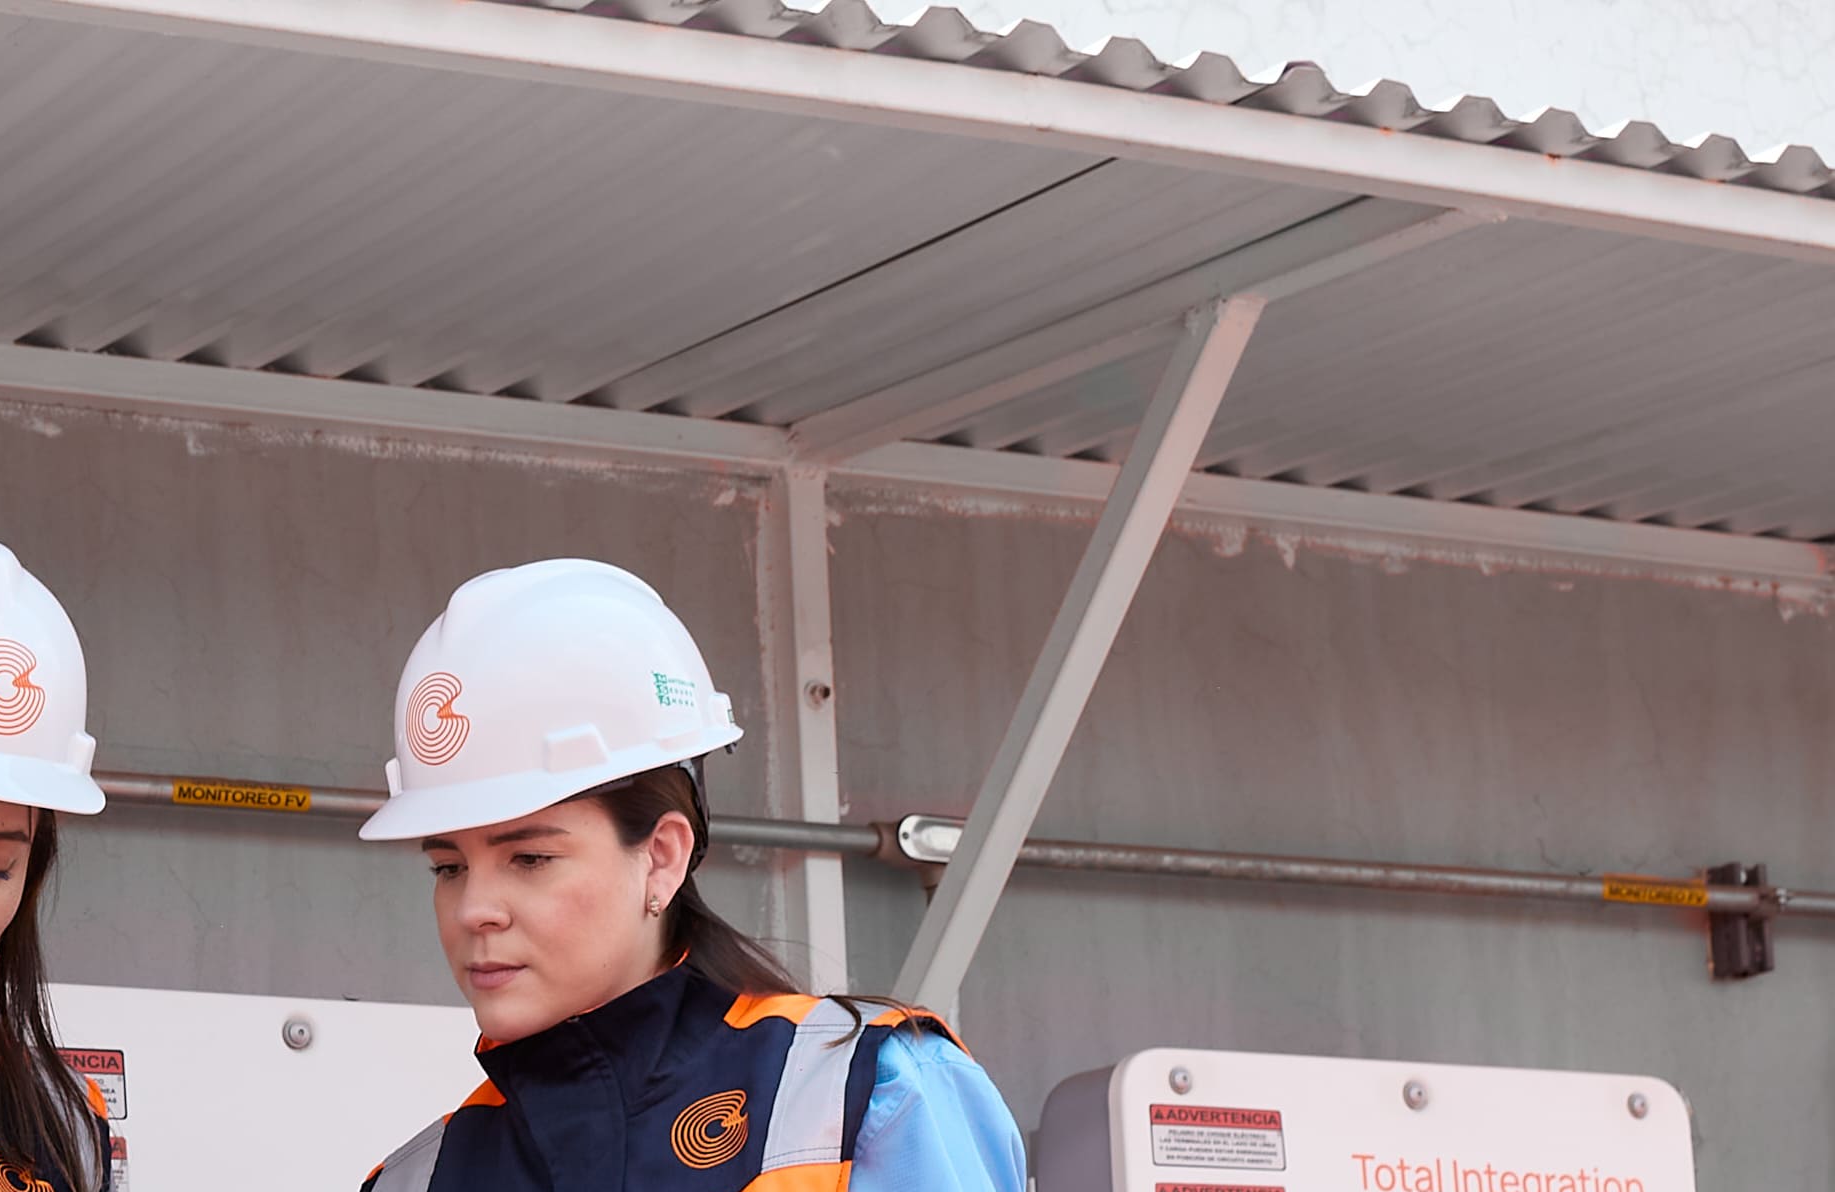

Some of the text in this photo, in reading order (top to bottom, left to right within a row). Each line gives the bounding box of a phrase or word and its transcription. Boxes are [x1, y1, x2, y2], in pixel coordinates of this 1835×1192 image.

[178, 786, 281, 806] MONITOREO
[285, 794, 307, 807] FV
[1167, 1109, 1278, 1125] ADVERTENCIA
